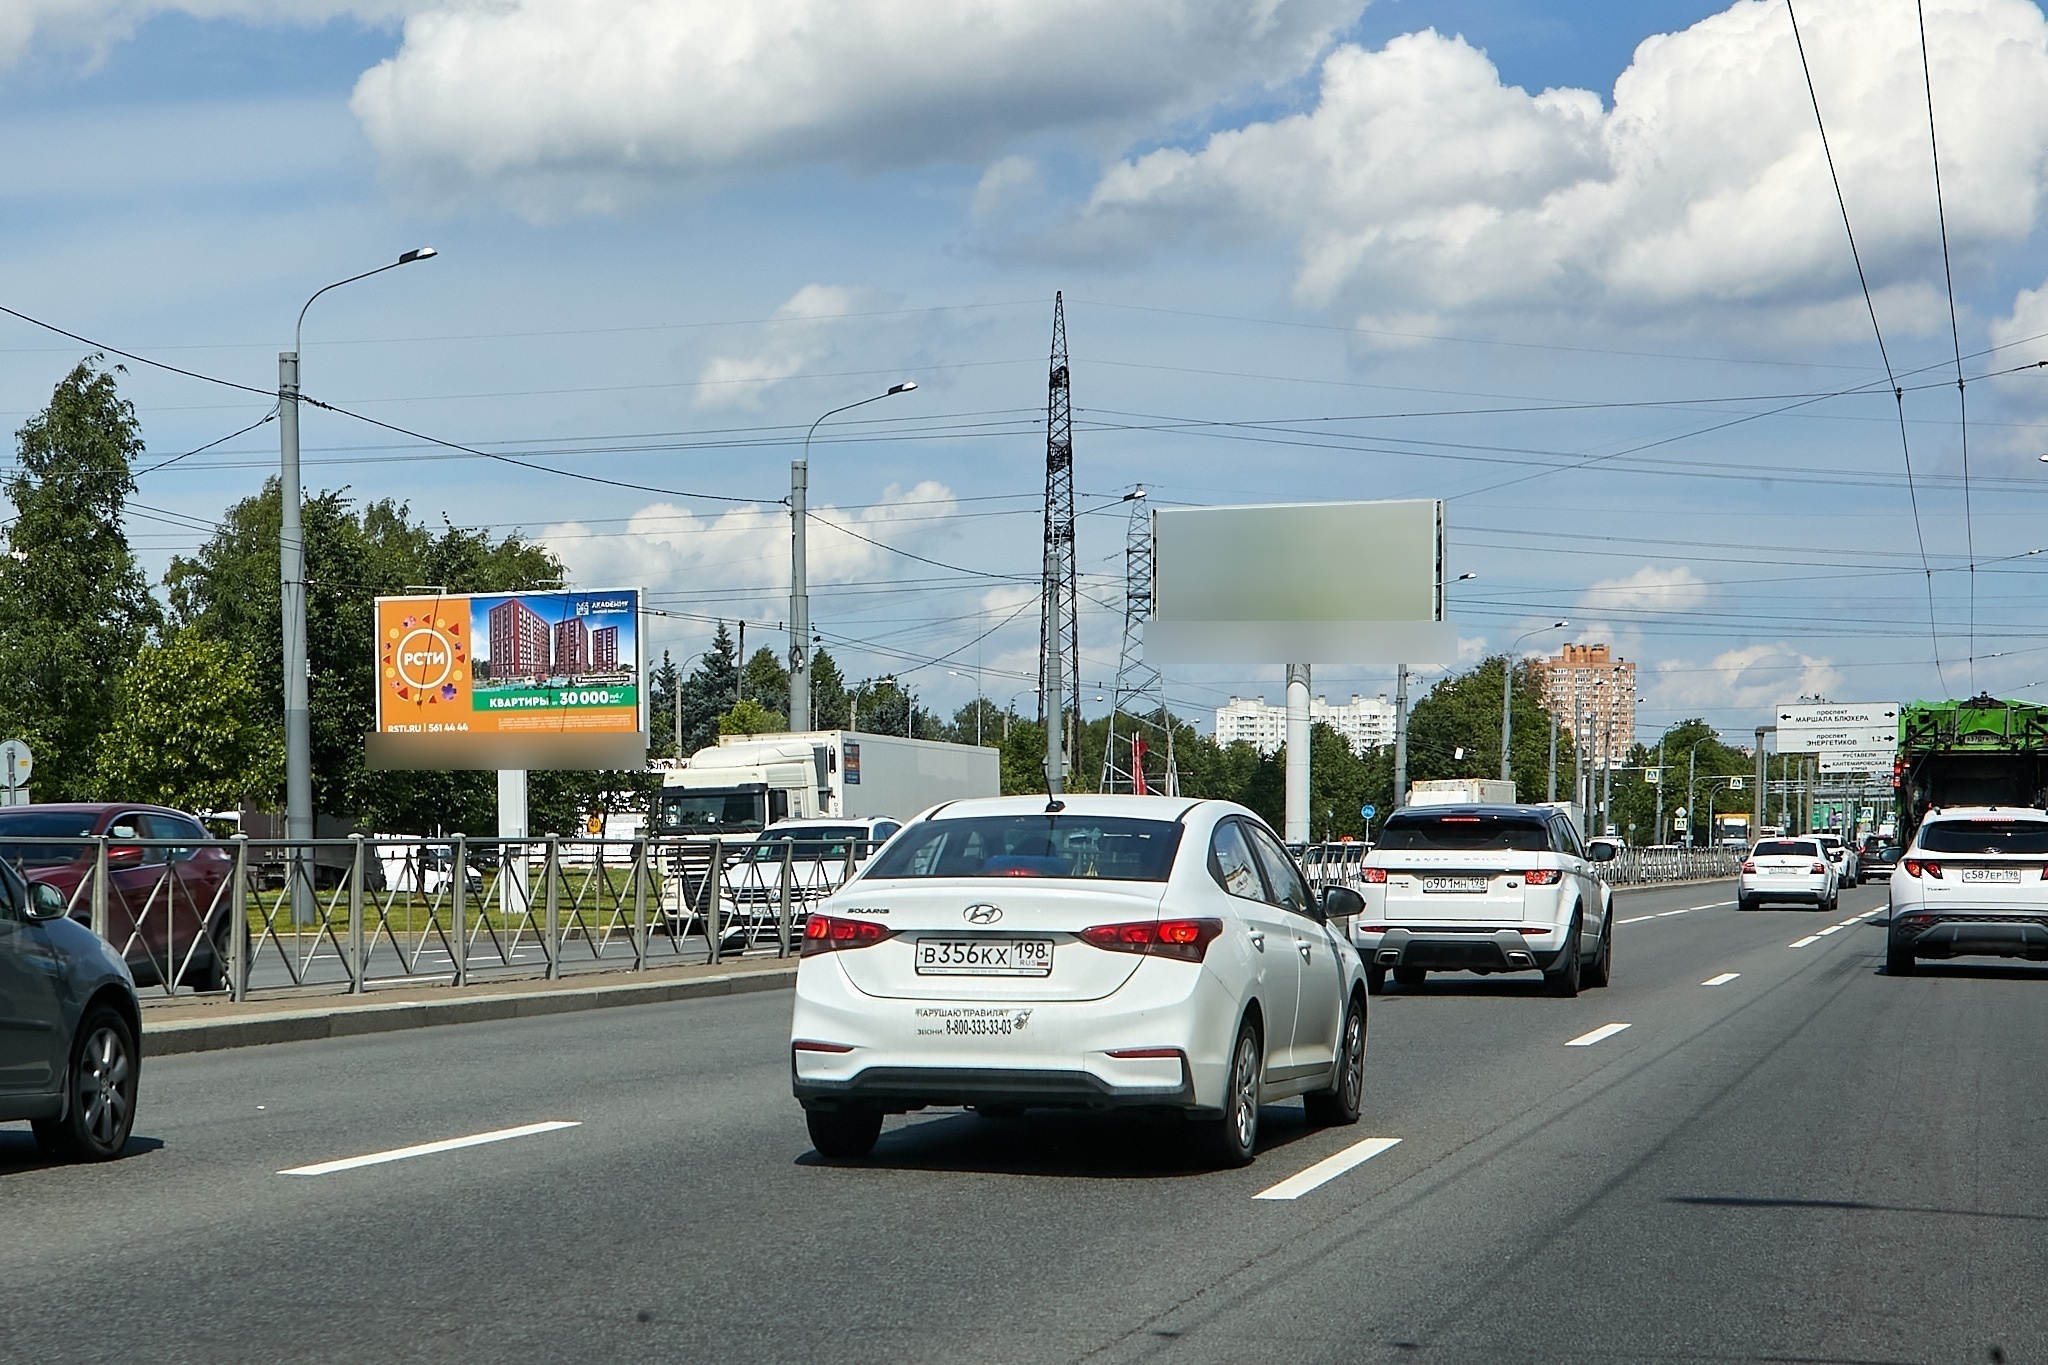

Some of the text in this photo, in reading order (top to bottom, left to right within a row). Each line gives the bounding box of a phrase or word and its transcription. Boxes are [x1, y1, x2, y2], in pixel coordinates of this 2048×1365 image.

[404, 651, 445, 666] РСТИ
[489, 697, 550, 708] КВАРТИРЫ
[559, 692, 579, 706] 30
[579, 691, 609, 705] 000
[388, 723, 469, 733] RSTI.RU 561 44 44
[1965, 870, 2019, 879] С587ЕР 198
[1426, 877, 1486, 889] О901МН 198
[924, 942, 1046, 965] В356КХ 198
[1019, 959, 1036, 967] RUS
[916, 1009, 962, 1017] НАРУШАЮ
[946, 1019, 1012, 1035] 8-800-333-33-03
